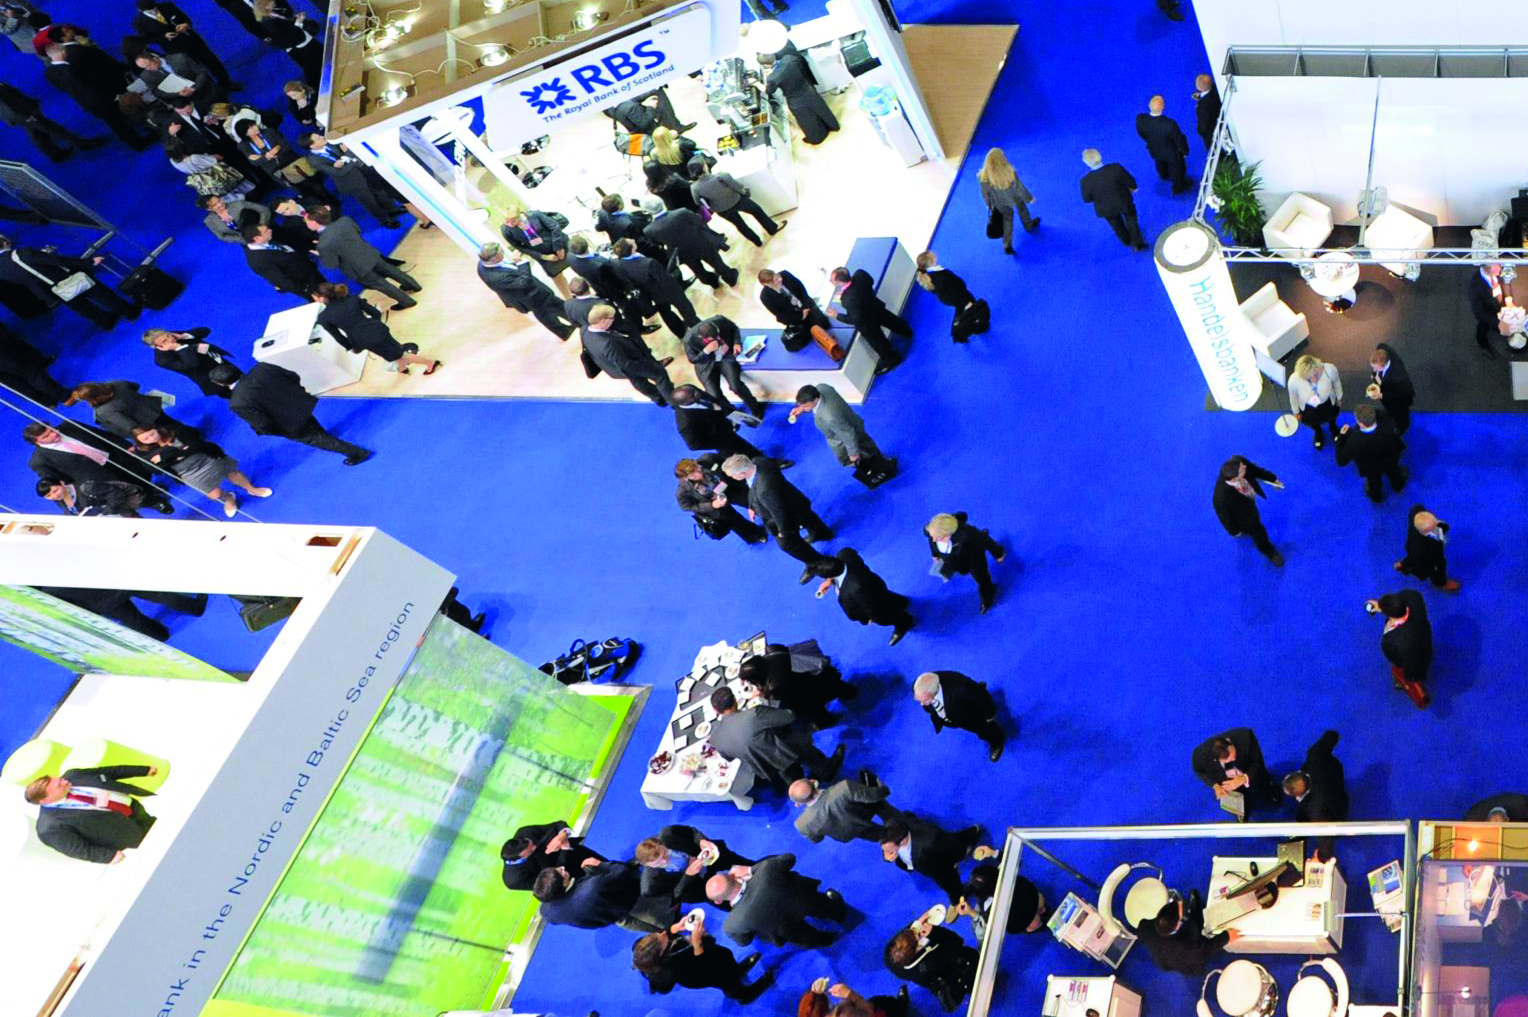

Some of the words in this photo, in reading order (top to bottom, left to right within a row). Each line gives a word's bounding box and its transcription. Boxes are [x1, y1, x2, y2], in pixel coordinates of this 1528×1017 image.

[543, 112, 562, 124] The
[564, 99, 593, 118] Royal
[594, 88, 620, 103] Bank
[621, 81, 632, 93] of
[632, 64, 675, 86] Scotland
[571, 39, 666, 95] RBS
[1188, 275, 1248, 403] Handelsbanken
[156, 977, 189, 1017] ank
[182, 949, 206, 979] in
[202, 903, 232, 941] the
[228, 819, 283, 895] Nordic
[281, 773, 310, 815] and
[306, 709, 350, 767] Baltic
[346, 666, 377, 703] Sea
[374, 601, 415, 663] region
